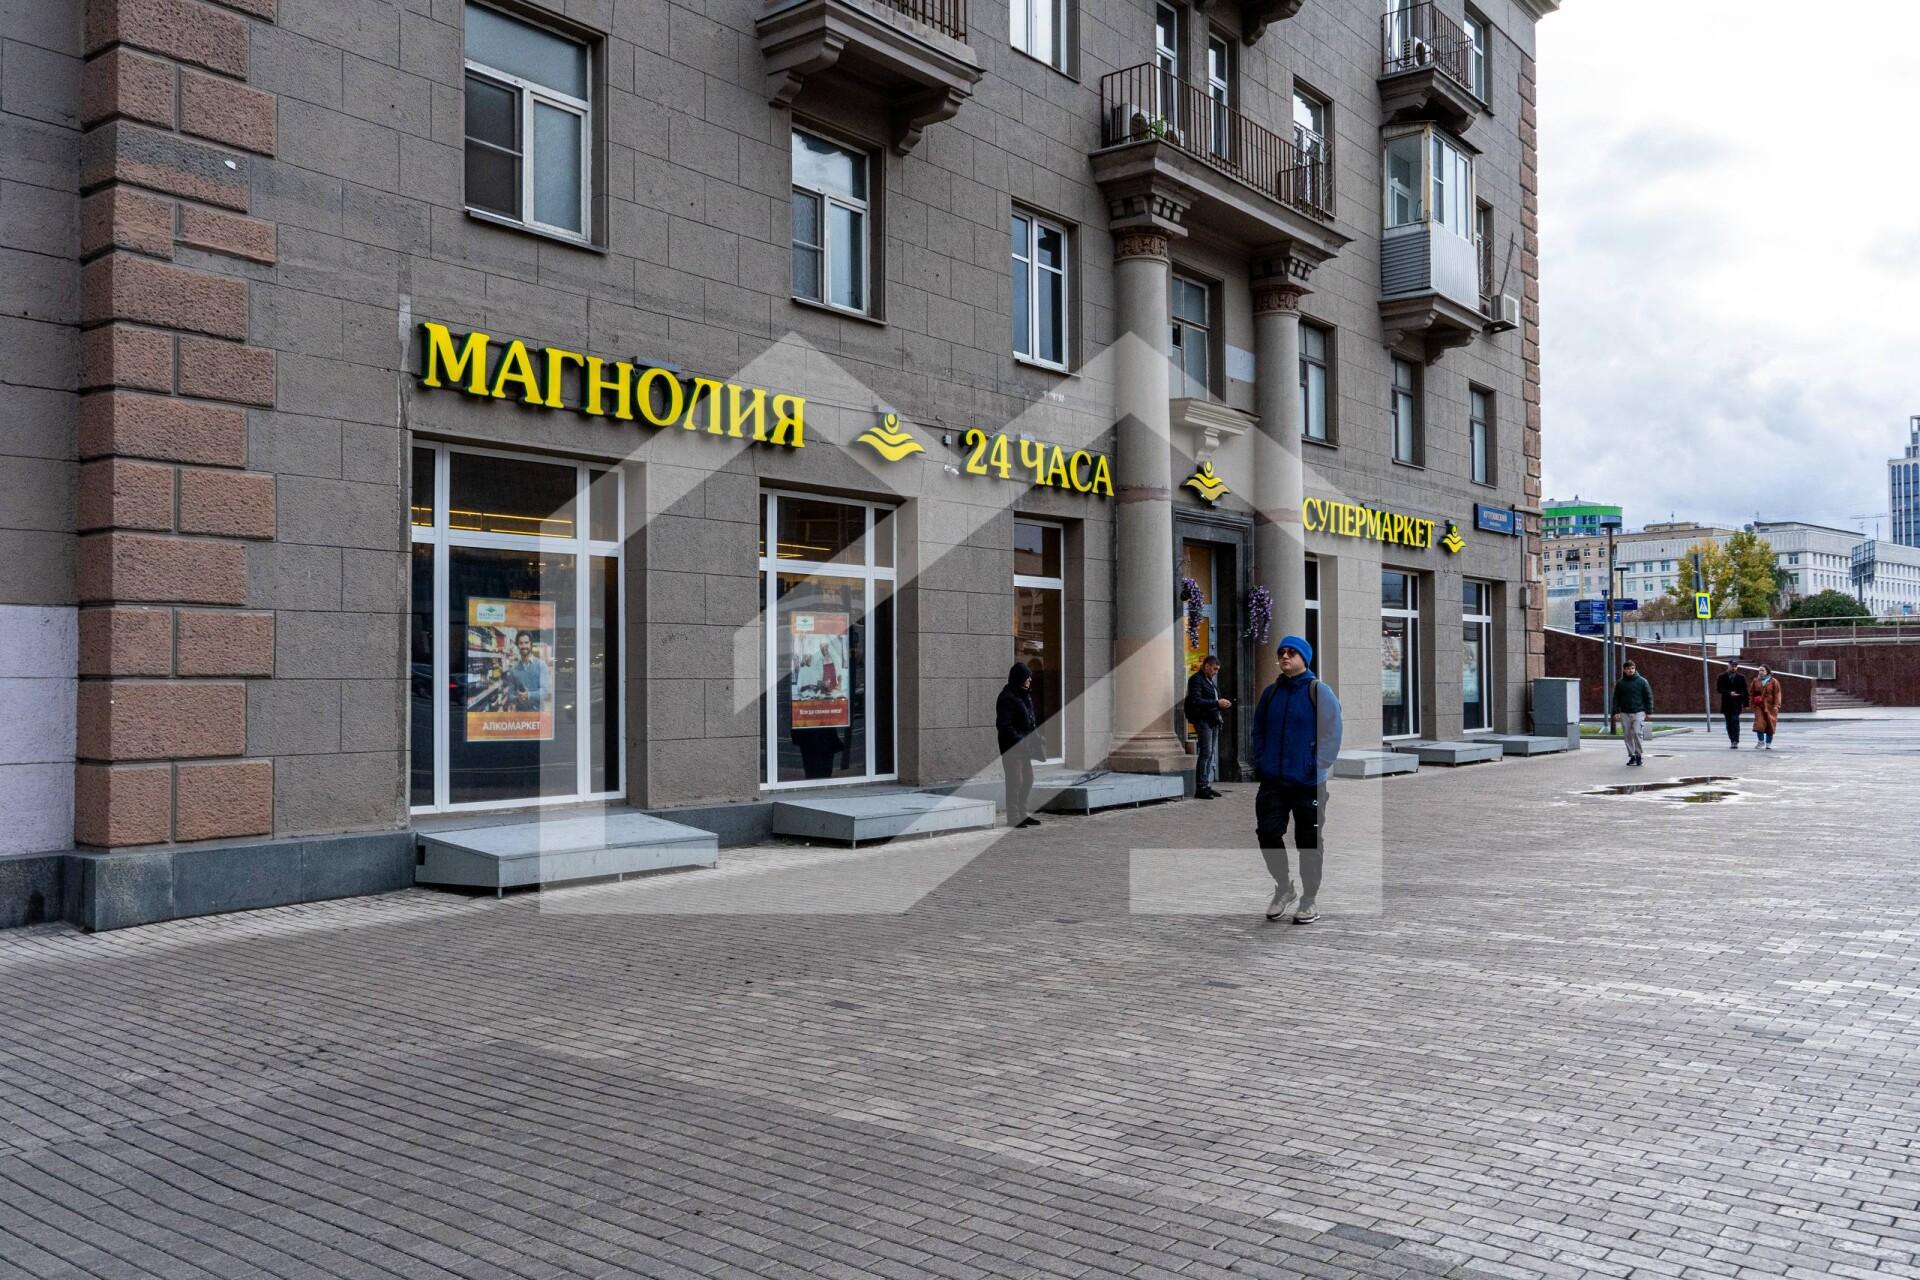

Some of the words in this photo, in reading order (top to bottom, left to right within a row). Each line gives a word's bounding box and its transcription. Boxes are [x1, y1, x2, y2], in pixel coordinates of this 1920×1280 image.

[422, 322, 806, 448] МАГНОЛИЯ
[965, 428, 1012, 479] 24
[1019, 439, 1115, 497] ЧАСА
[1302, 497, 1435, 549] СУПЕРМАРКЕТ
[482, 721, 541, 731] АЛКОМАРКЕТ
